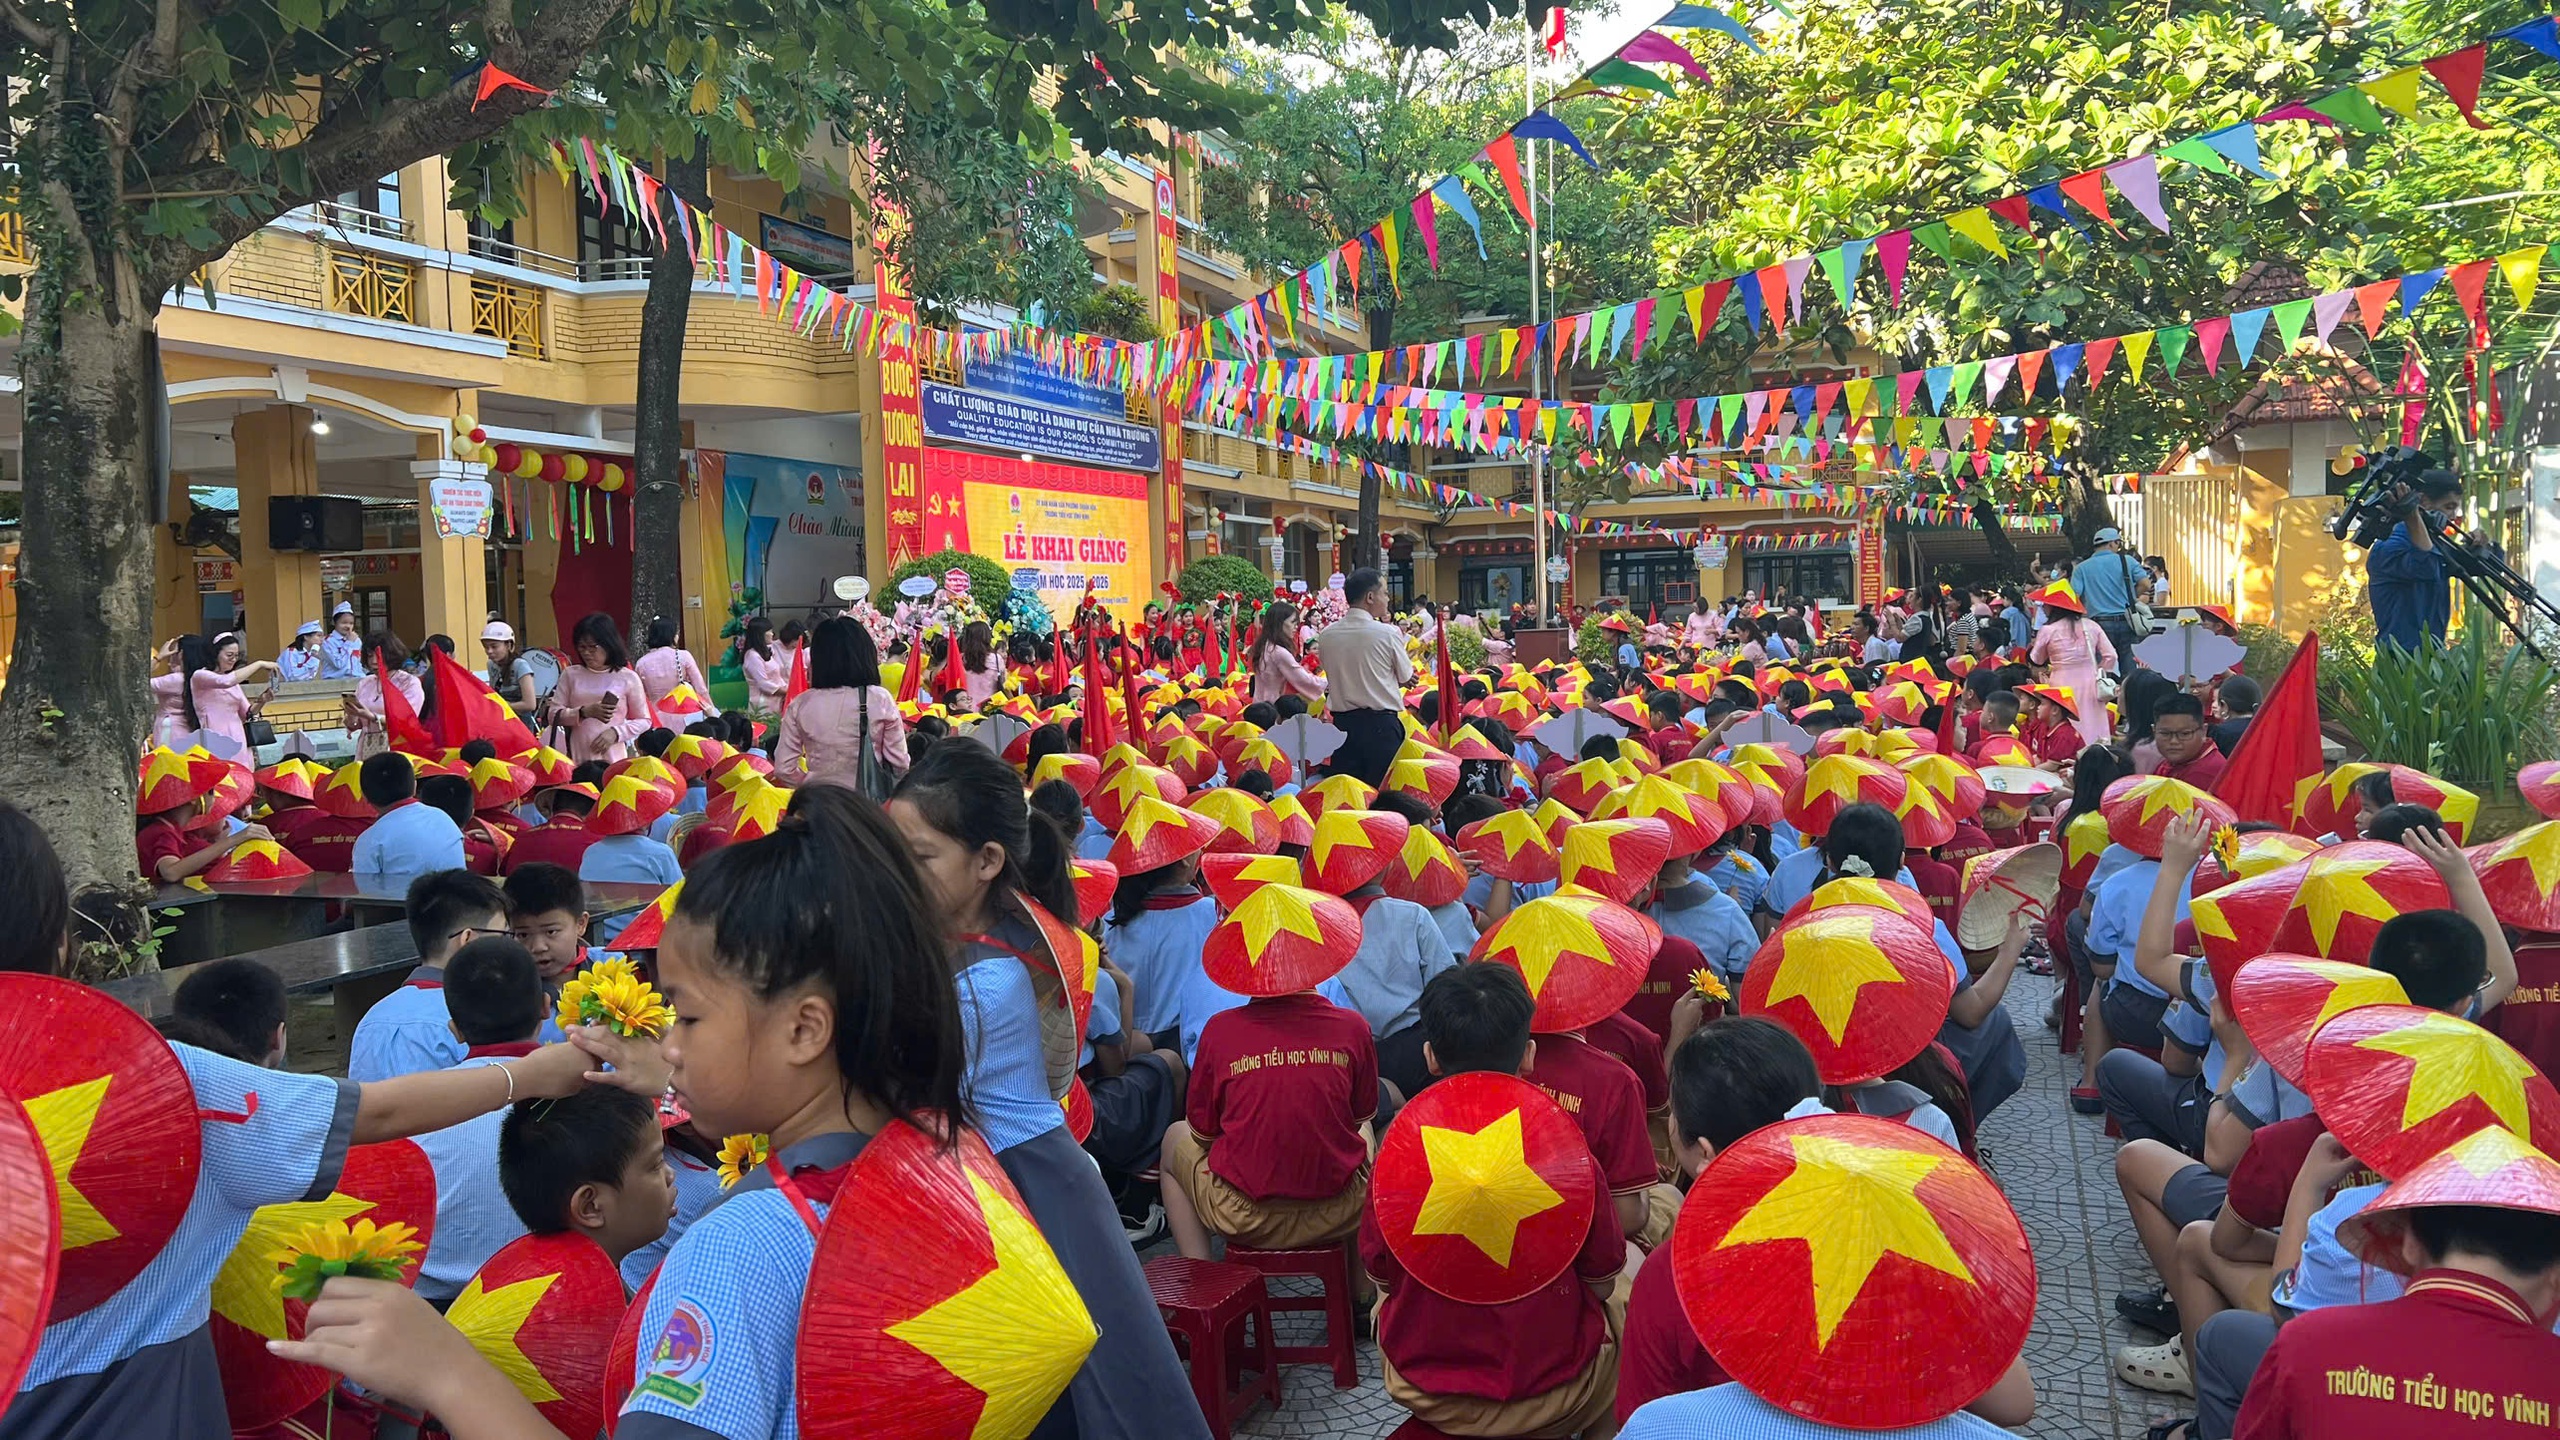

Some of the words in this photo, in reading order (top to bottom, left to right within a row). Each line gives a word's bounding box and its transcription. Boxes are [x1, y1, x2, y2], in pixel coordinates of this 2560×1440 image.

[883, 356, 914, 398] BƯỚC
[883, 409, 919, 448] TƯƠNG
[933, 390, 960, 407] CHẤT
[962, 396, 995, 414] LƯỢNG
[997, 403, 1019, 419] GIÁO
[1021, 408, 1039, 424] DỤC
[1040, 411, 1051, 425] LÀ
[1052, 414, 1075, 430] DANH
[1076, 419, 1088, 434] DỰ
[1089, 420, 1105, 434] CỦA
[1106, 425, 1122, 438] NHÀ
[1122, 428, 1150, 443] TRƯỜNG
[957, 410, 991, 425] QUALITY
[994, 418, 1035, 433] EDUCATION
[1038, 426, 1044, 434] IS
[1047, 428, 1061, 438] OUR
[1062, 430, 1096, 444] SCHOOL'S
[1097, 437, 1136, 450] COMMITMENT
[890, 462, 915, 497] LAI
[788, 512, 822, 536] Chào
[826, 516, 864, 542] Mừng
[1004, 523, 1026, 560] LỄ
[1032, 536, 1074, 561] KHAI
[1080, 533, 1126, 564] GIẢNG
[1050, 574, 1064, 590] HỌC
[1067, 576, 1084, 589] 2025
[1093, 576, 1108, 589] 2026
[536, 653, 554, 666] VICTORIA
[1653, 981, 1670, 994] NINH
[2544, 982, 2560, 1002] TIỂ
[1230, 1054, 1261, 1076] TRƯỜNG
[1264, 1046, 1284, 1067] TIỂU
[1287, 1050, 1306, 1067] HỌC
[1308, 1048, 1330, 1064] VĨNH
[1332, 1051, 1349, 1069] NINH
[1559, 1092, 1582, 1114] NINH
[2326, 1364, 2395, 1400] TRƯỜNG
[2403, 1372, 2447, 1410] TIỂU
[2454, 1388, 2494, 1420] HỌC
[2503, 1394, 2550, 1427] VĨNH
